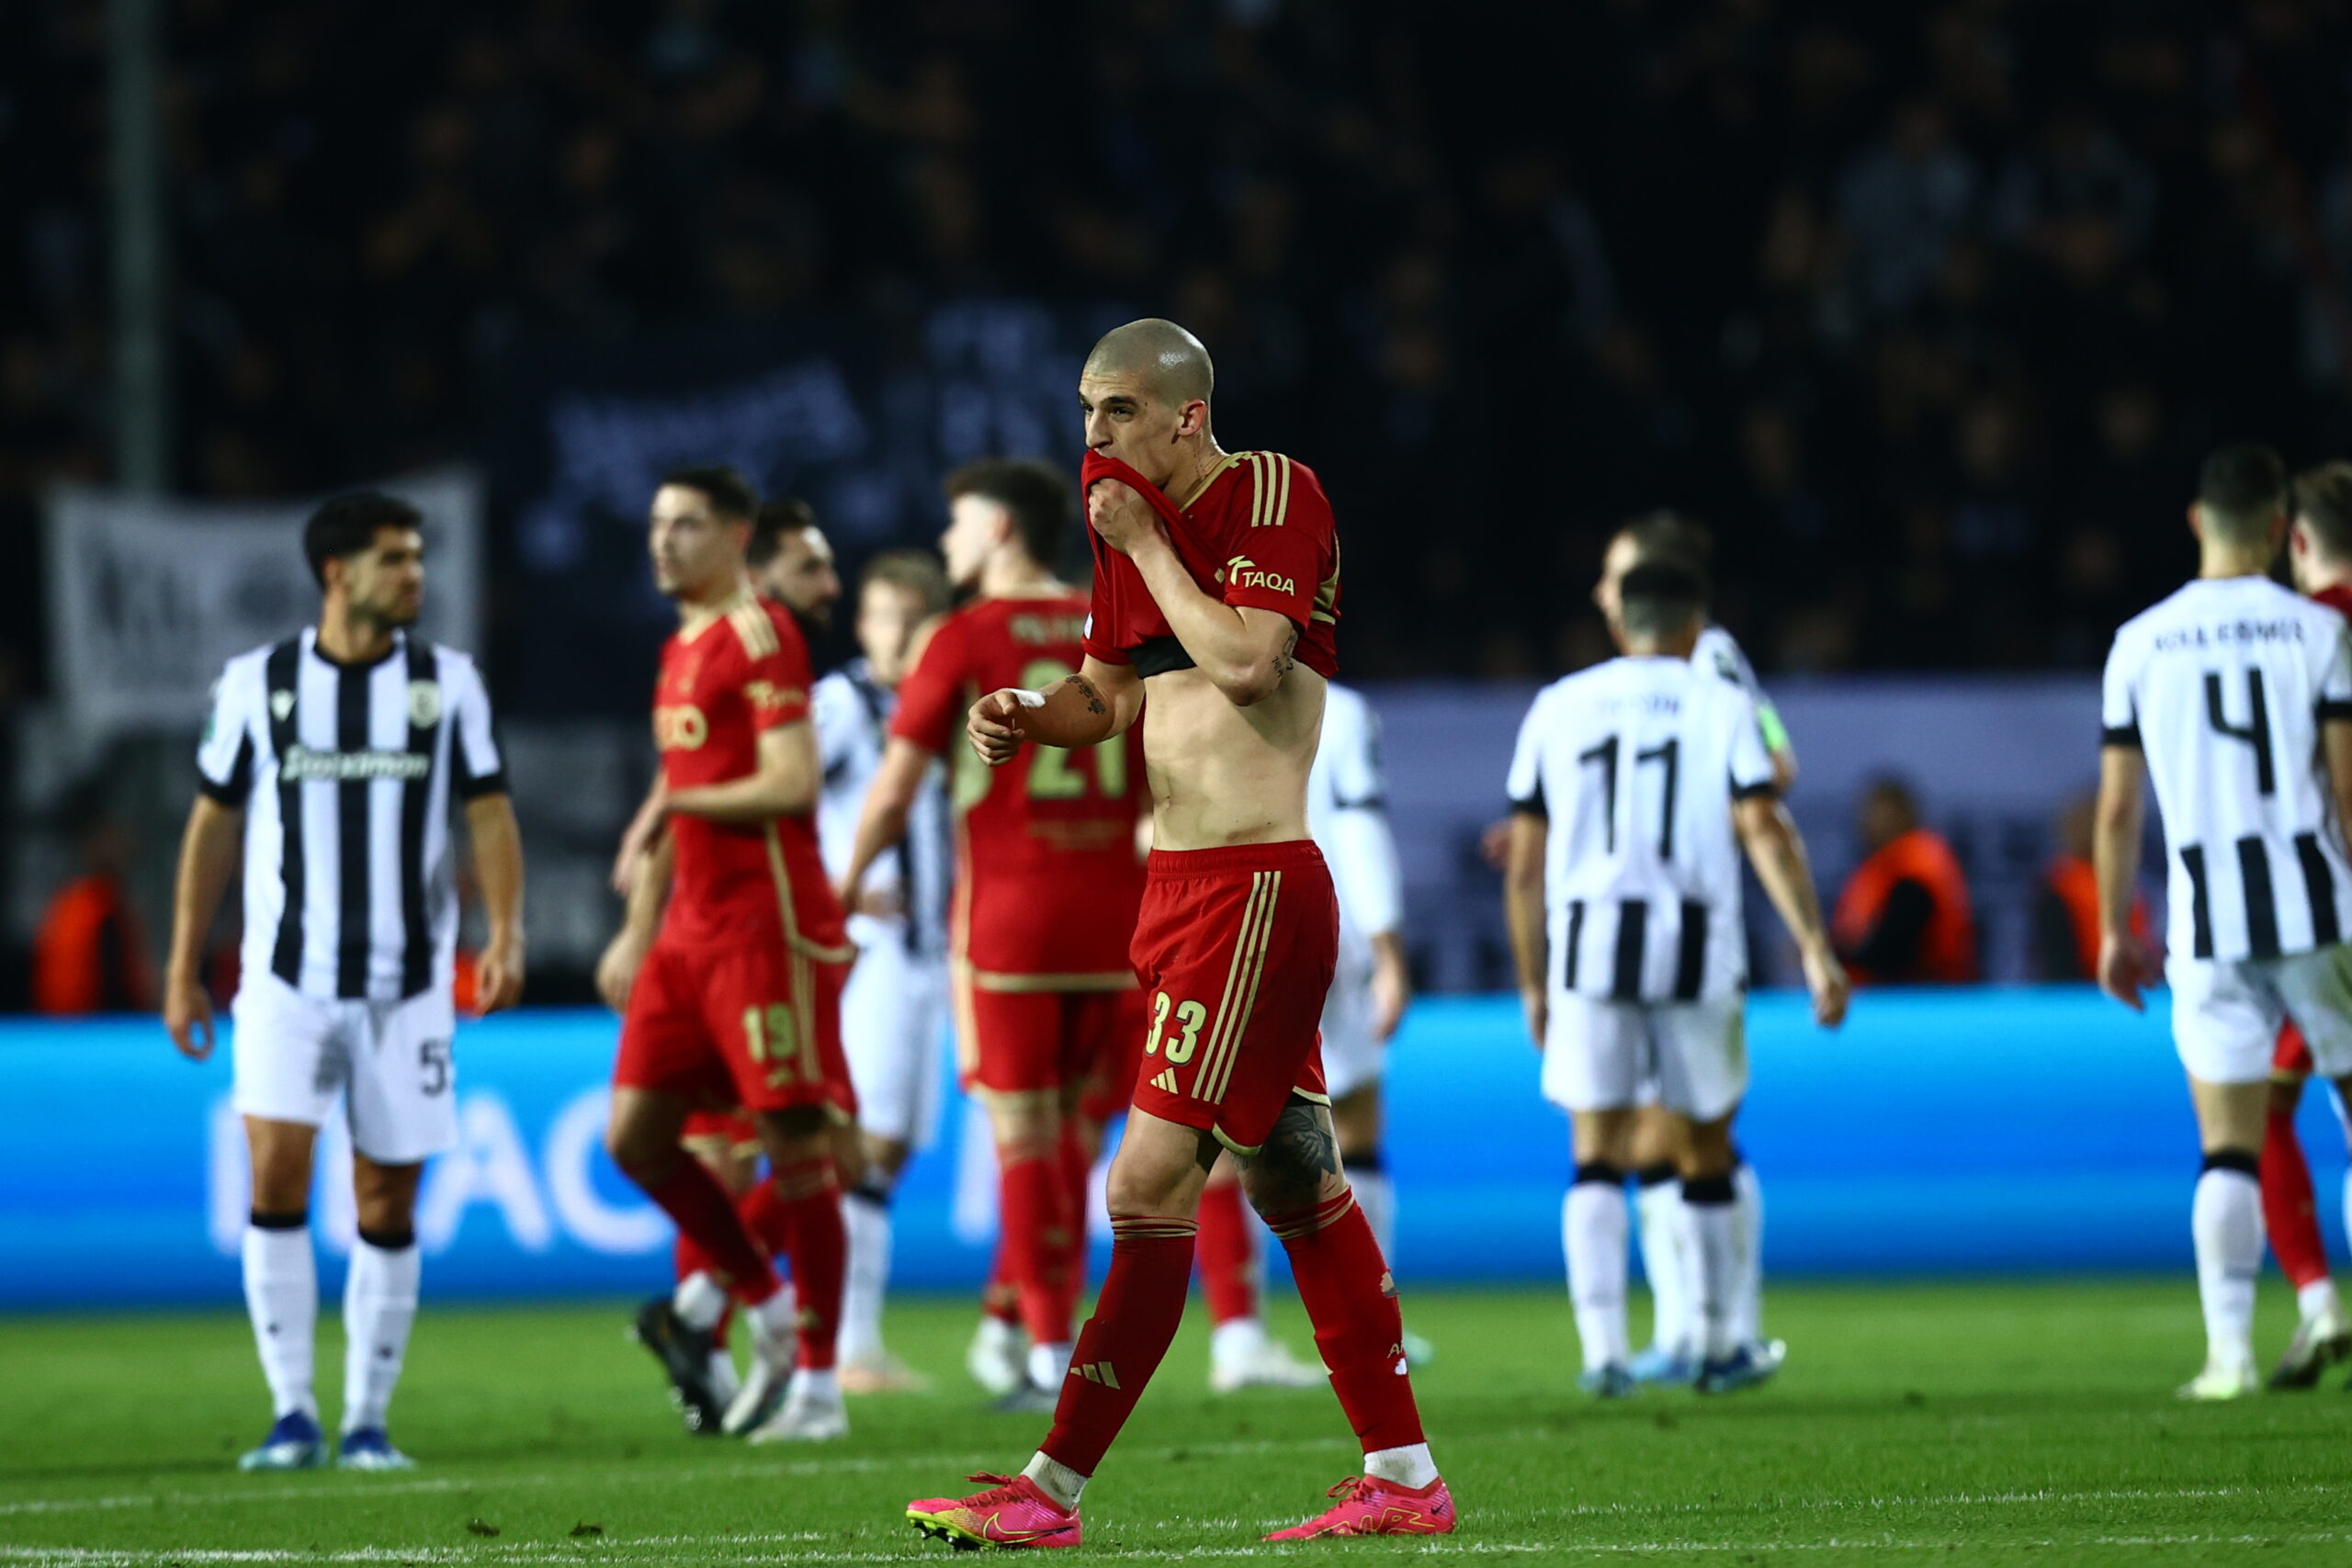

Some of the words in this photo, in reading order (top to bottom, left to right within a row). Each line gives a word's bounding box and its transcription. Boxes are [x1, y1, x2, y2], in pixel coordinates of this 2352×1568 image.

[1242, 570, 1295, 597] TAQA
[2205, 668, 2275, 795] 4
[1578, 733, 1679, 862] 11
[741, 1004, 794, 1063] 19
[1146, 991, 1207, 1066] 33
